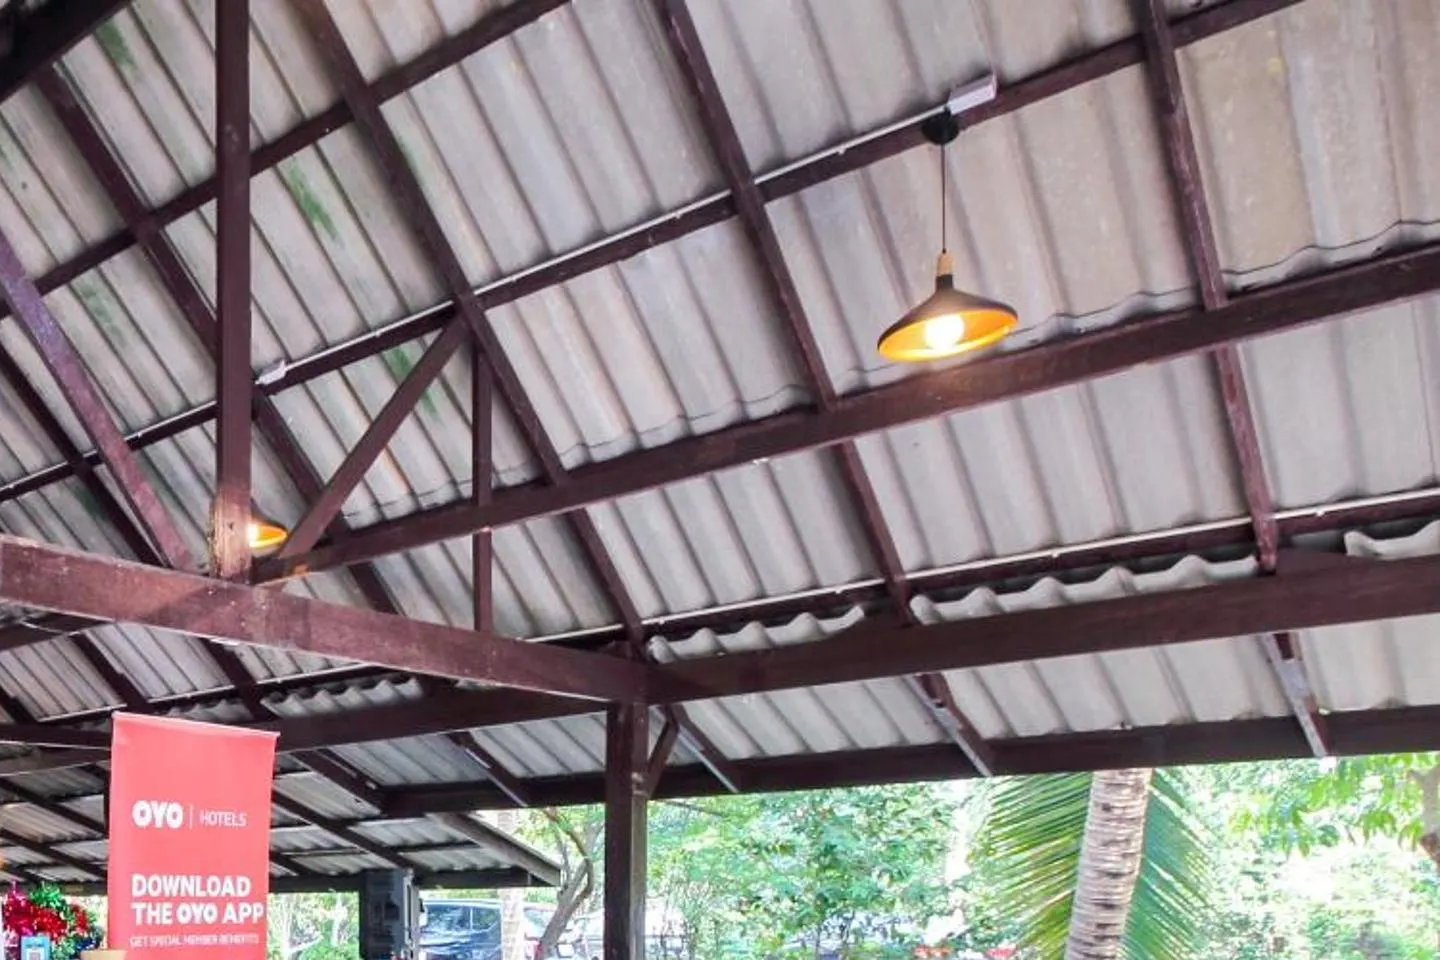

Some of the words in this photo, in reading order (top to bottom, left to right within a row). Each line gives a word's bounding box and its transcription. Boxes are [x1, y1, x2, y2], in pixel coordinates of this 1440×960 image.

[132, 800, 184, 828] OYO
[200, 810, 247, 827] HOTELS
[131, 874, 250, 898] DOWNLOAD
[131, 902, 172, 925] THE
[176, 903, 218, 925] OYO
[223, 902, 264, 924] APP
